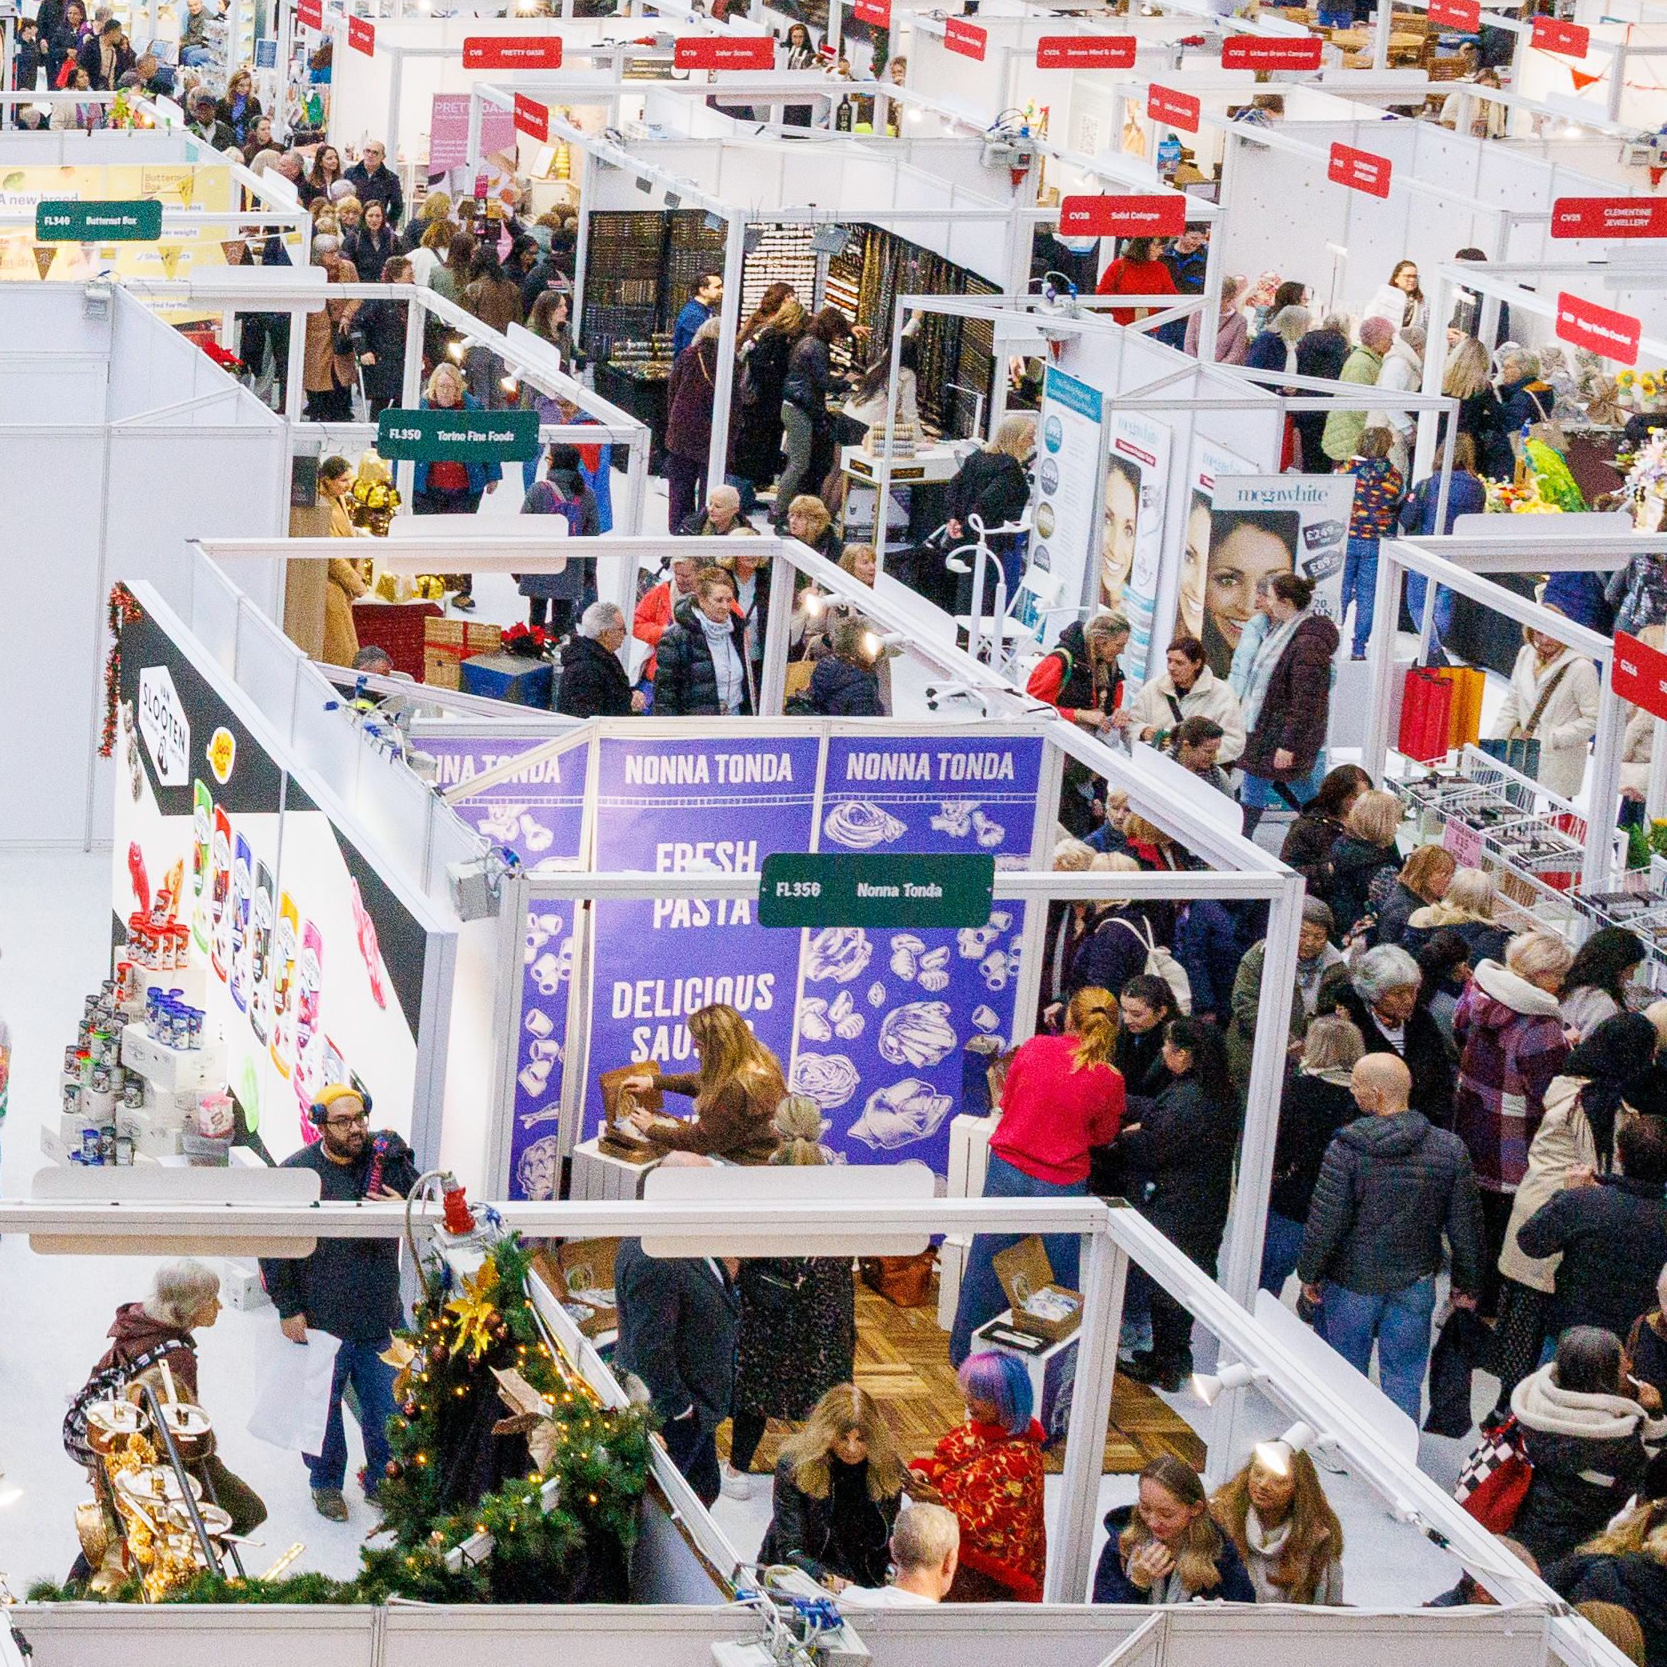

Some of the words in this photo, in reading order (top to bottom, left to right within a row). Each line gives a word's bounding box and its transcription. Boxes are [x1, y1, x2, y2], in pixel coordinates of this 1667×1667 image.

[501, 49, 525, 57] PRETTY
[525, 49, 544, 57] OASIS
[122, 215, 136, 225] Box
[1112, 211, 1129, 220] Solid
[1130, 211, 1160, 221] Cologne
[1604, 208, 1652, 217] CLEMENTINE
[1605, 217, 1649, 226] JEWELLERY
[438, 430, 465, 441] Torino
[467, 430, 487, 441] Fine
[487, 430, 514, 441] Foods
[1238, 484, 1329, 505] megawhite
[141, 682, 186, 757] SLOOTEN
[624, 754, 705, 784] NONNA
[709, 753, 793, 783] TONDA
[847, 752, 928, 781] NONNA
[932, 751, 1014, 780] TONDA
[657, 841, 757, 872] FRESH
[857, 882, 899, 897] Nonna
[903, 882, 942, 897] Tonda
[655, 898, 753, 929] PASTA
[612, 973, 774, 1022] DELICIOUS
